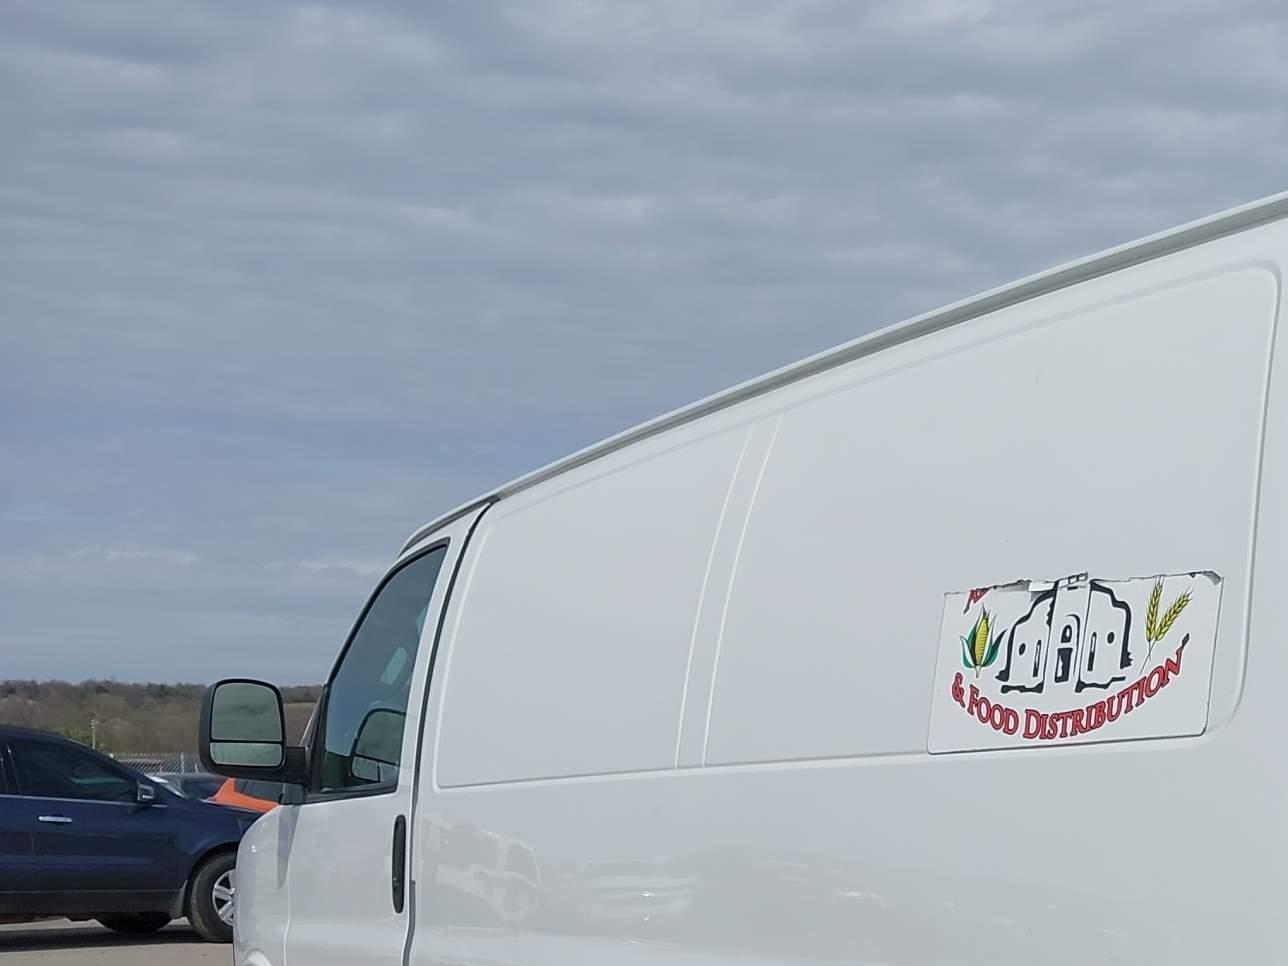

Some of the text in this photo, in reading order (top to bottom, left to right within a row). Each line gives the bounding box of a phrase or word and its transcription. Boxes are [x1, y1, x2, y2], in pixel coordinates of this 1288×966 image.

[952, 648, 1184, 740] & FOOD DISTRIBUTION
